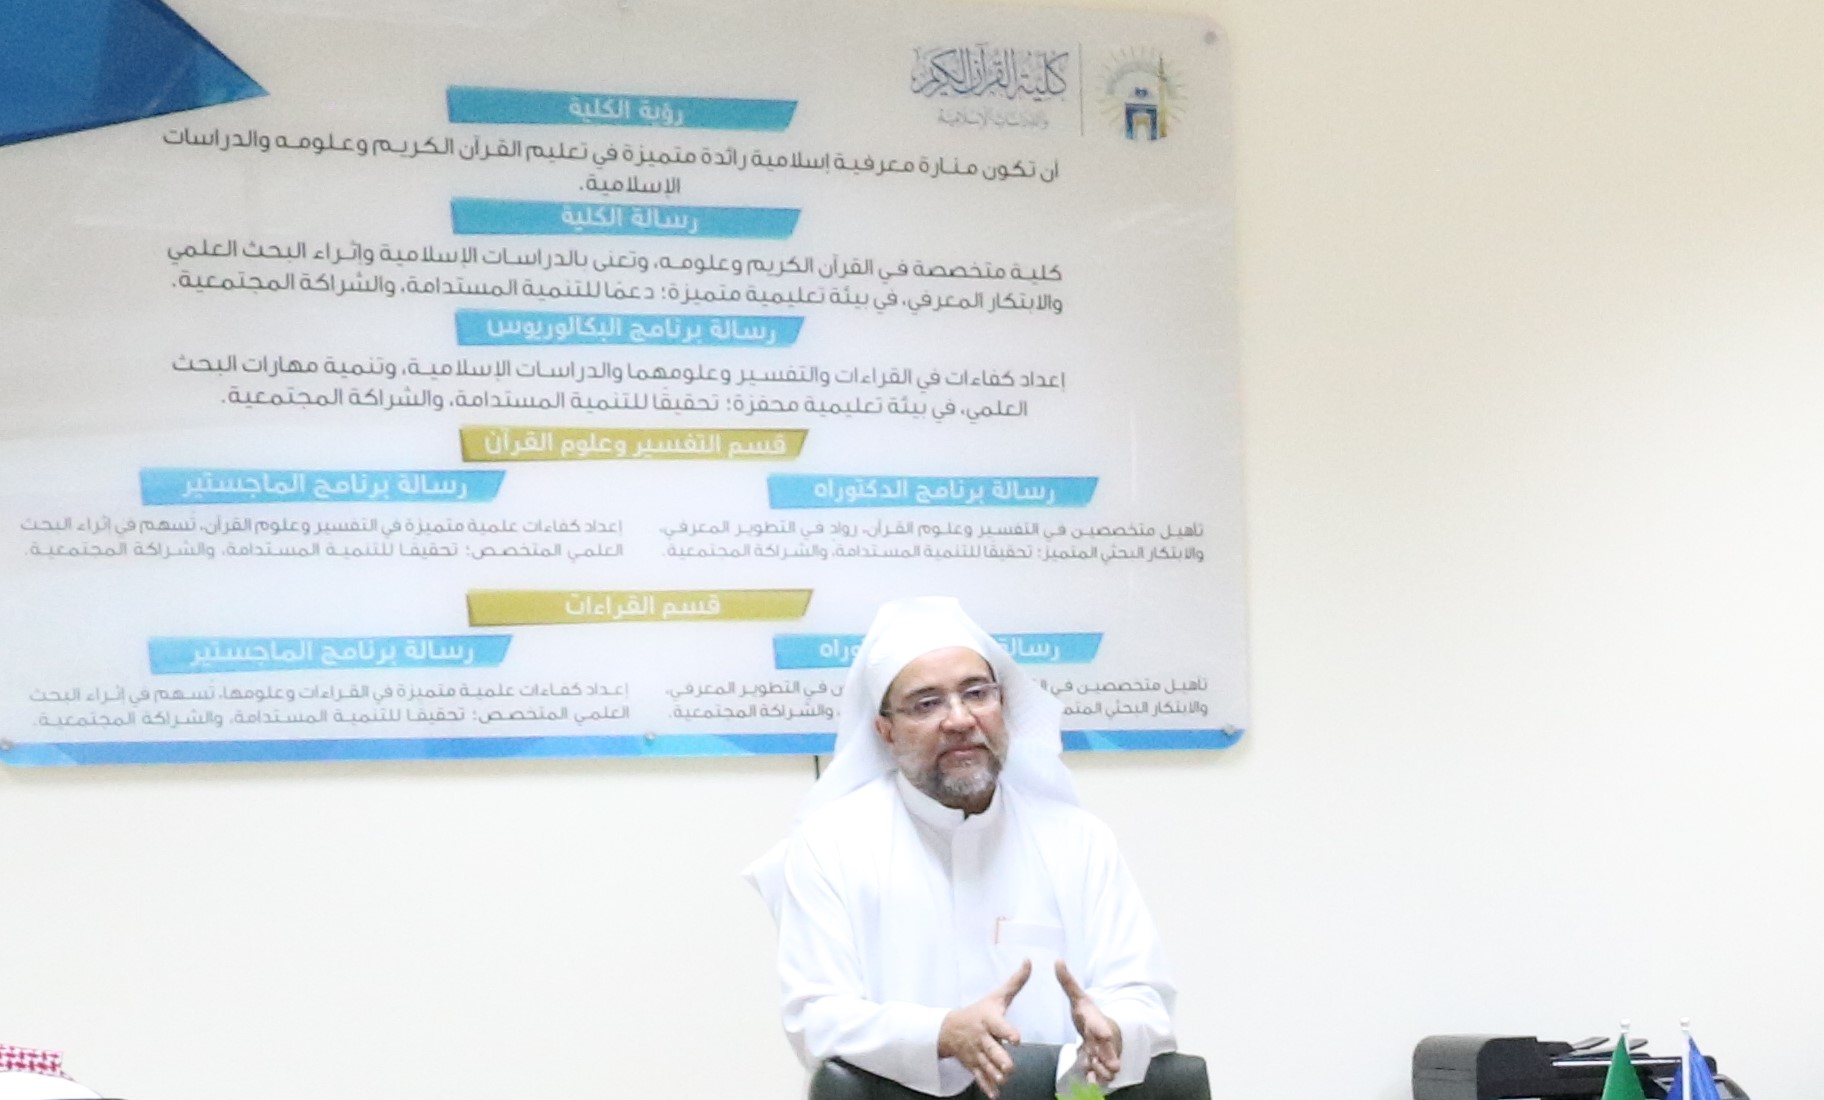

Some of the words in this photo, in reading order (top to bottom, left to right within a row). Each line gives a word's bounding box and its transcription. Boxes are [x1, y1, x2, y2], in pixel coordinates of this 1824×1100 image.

[569, 96, 631, 122] الكلية
[639, 103, 685, 129] رؤية
[164, 127, 270, 153] والدراسات
[276, 133, 369, 157] وعلومه
[372, 136, 454, 159] الكريم
[459, 135, 522, 161] القرآن
[525, 142, 589, 163] تعليم
[592, 144, 618, 167] في
[623, 144, 697, 169] متميزة
[701, 147, 748, 172] رائدة
[753, 151, 829, 175] إسلامية
[834, 155, 915, 177] معرفية
[921, 156, 978, 178] منارة
[982, 158, 1036, 182] تكون
[560, 204, 623, 231] الكلية
[631, 207, 698, 234] رسالة
[167, 238, 238, 265] العلمي
[242, 239, 307, 264] البحث
[380, 243, 477, 268] الإسلامية
[482, 247, 587, 273] بالدراسات
[592, 250, 649, 275] وتعنى
[745, 255, 814, 279] الكريم
[818, 254, 873, 279] القرآن
[878, 262, 908, 285] في
[913, 259, 1005, 280] متخصصة
[1009, 262, 1063, 286] كلية
[299, 271, 396, 298] والشراكة
[522, 279, 601, 302] للتنمية
[745, 284, 826, 308] تعليمية
[830, 284, 869, 309] بيئة
[872, 290, 899, 315] في
[987, 291, 1064, 316] والابتكار
[486, 313, 623, 343] البكالوريوس
[629, 318, 703, 344] برنامج
[709, 318, 777, 345] رسالة
[172, 354, 237, 376] البحث
[241, 355, 319, 377] مهارات
[323, 355, 397, 380] وتنمية
[515, 359, 623, 383] والدراسات
[627, 362, 732, 386] وعلومهما
[739, 364, 831, 388] والتفسير
[834, 367, 913, 389] القراءات
[916, 371, 942, 394] في
[945, 368, 1015, 388] كفاءات
[1020, 371, 1066, 393] إعداد
[347, 385, 444, 411] والشراكة
[571, 391, 650, 414] للتنمية
[804, 395, 883, 418] تعليمية
[887, 394, 928, 419] بيئة
[931, 399, 957, 424] في
[484, 428, 554, 455] القرآن
[560, 433, 627, 457] وعلوم
[631, 432, 722, 458] التفسير
[726, 435, 788, 459] قسم
[181, 471, 306, 500] الماجستير
[314, 473, 390, 500] برنامج
[396, 474, 468, 499] رسالة
[814, 478, 909, 504] الدكتوراه
[914, 479, 985, 505] برنامج
[991, 479, 1056, 506] رسالة
[564, 593, 657, 619] القراءات
[662, 595, 721, 618] قسم
[190, 639, 313, 667] الماجستير
[320, 639, 398, 666] برنامج
[404, 639, 475, 664] رسالة
